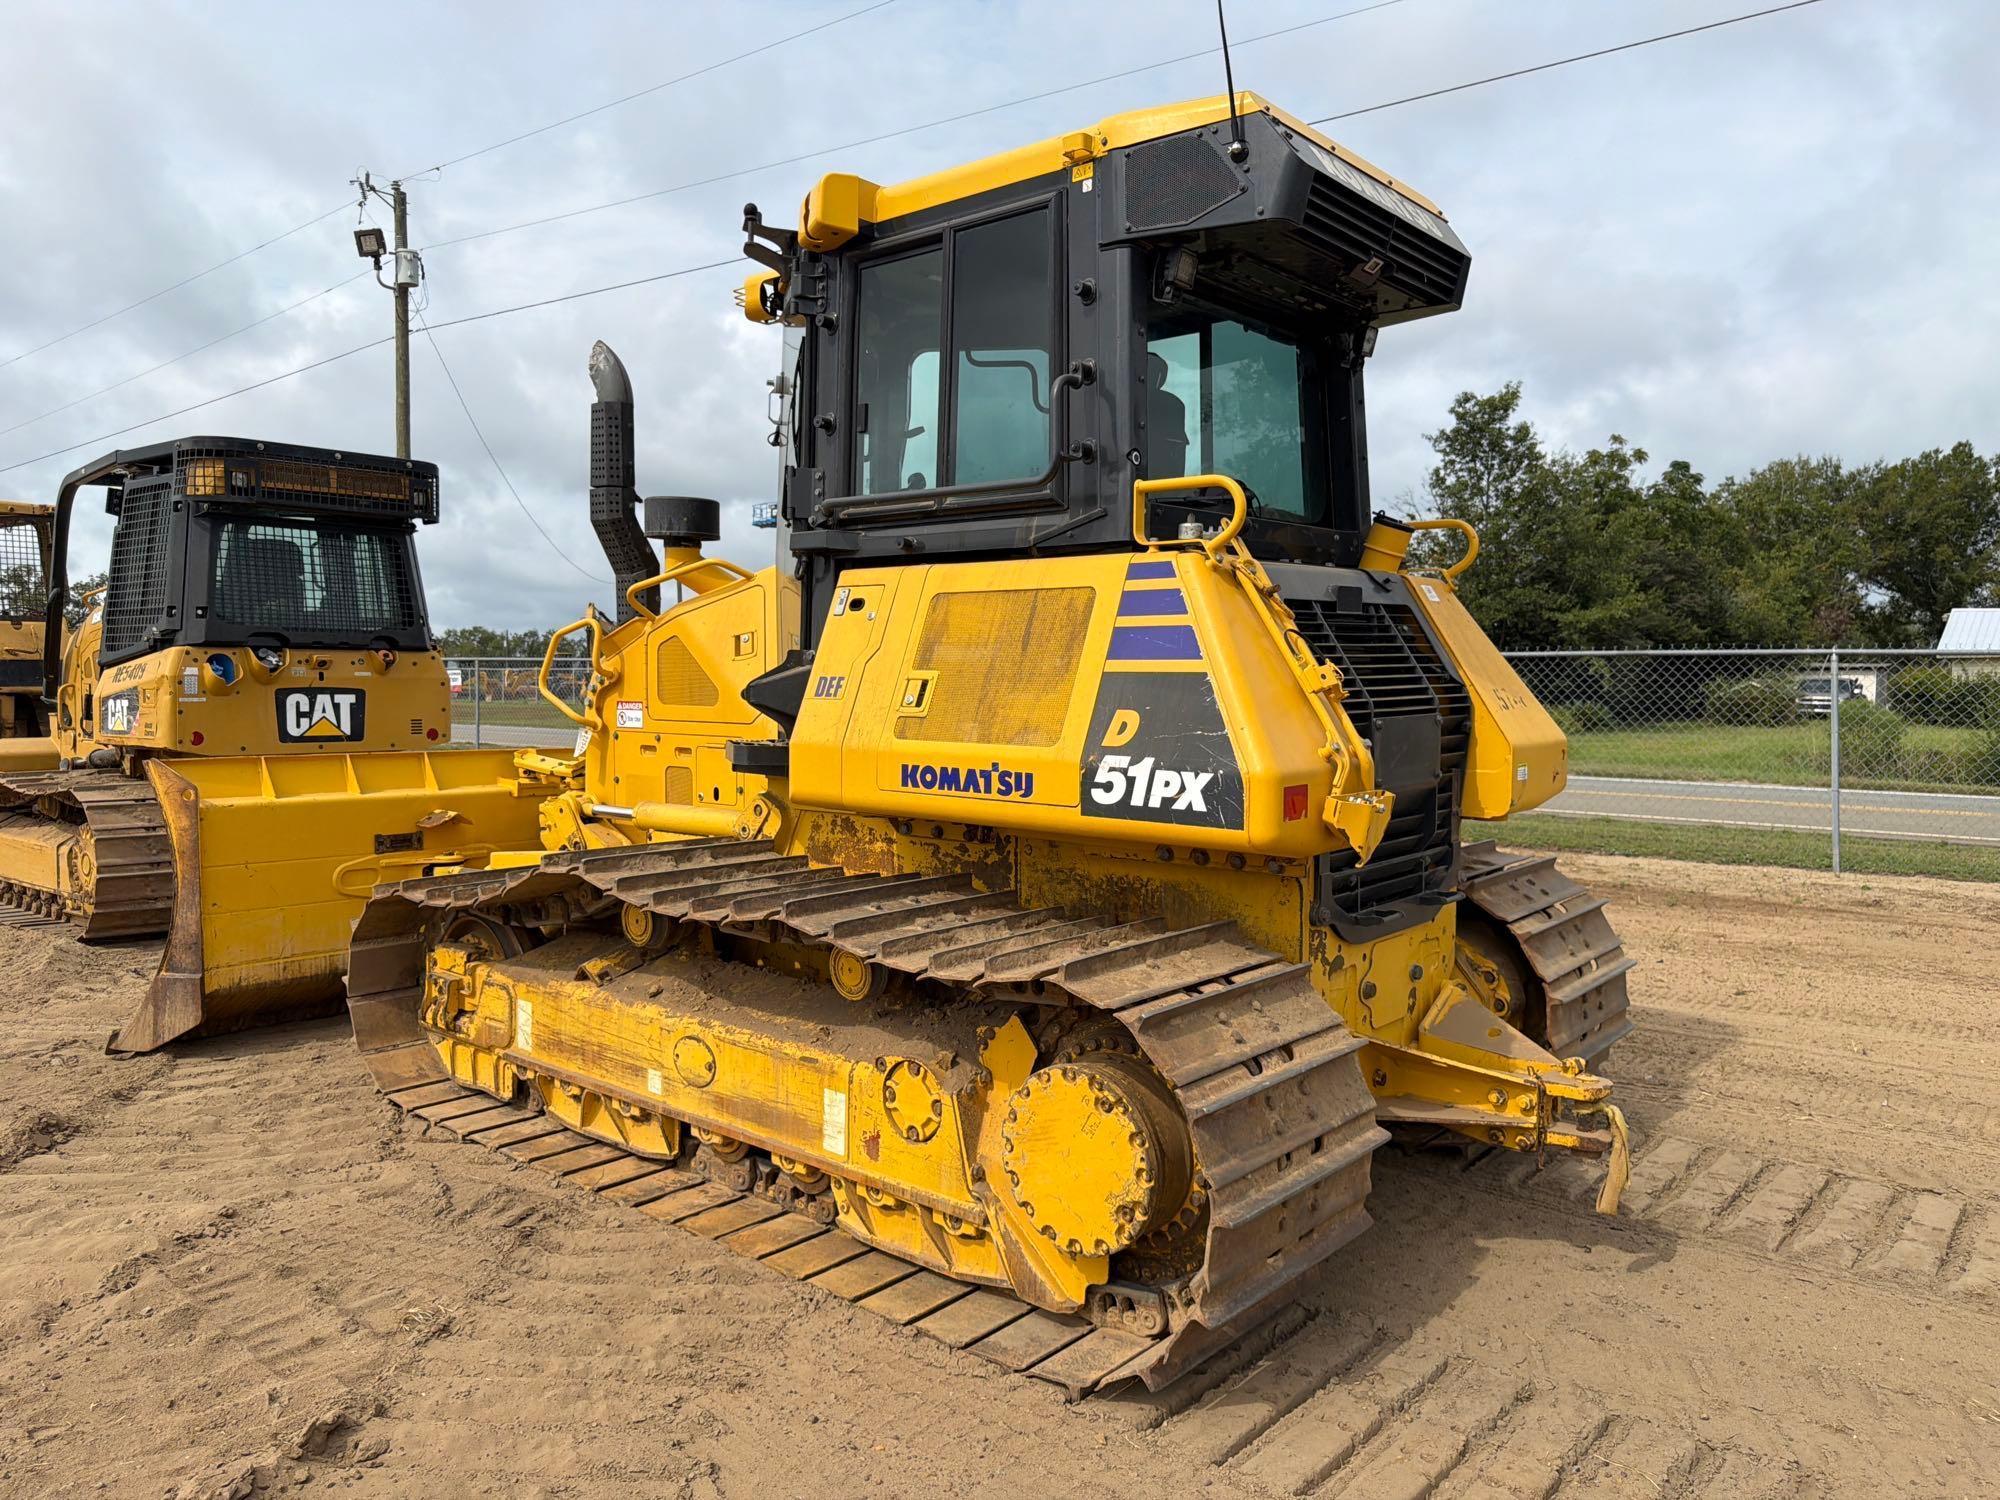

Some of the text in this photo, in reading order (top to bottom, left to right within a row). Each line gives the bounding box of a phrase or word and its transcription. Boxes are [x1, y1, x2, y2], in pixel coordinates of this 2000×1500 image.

[814, 676, 845, 697] DEF
[107, 698, 129, 731] CAT
[285, 692, 356, 737] CAT
[1101, 708, 1141, 747] D
[901, 762, 1033, 798] KOMATSU
[1091, 754, 1214, 812] 51PX
